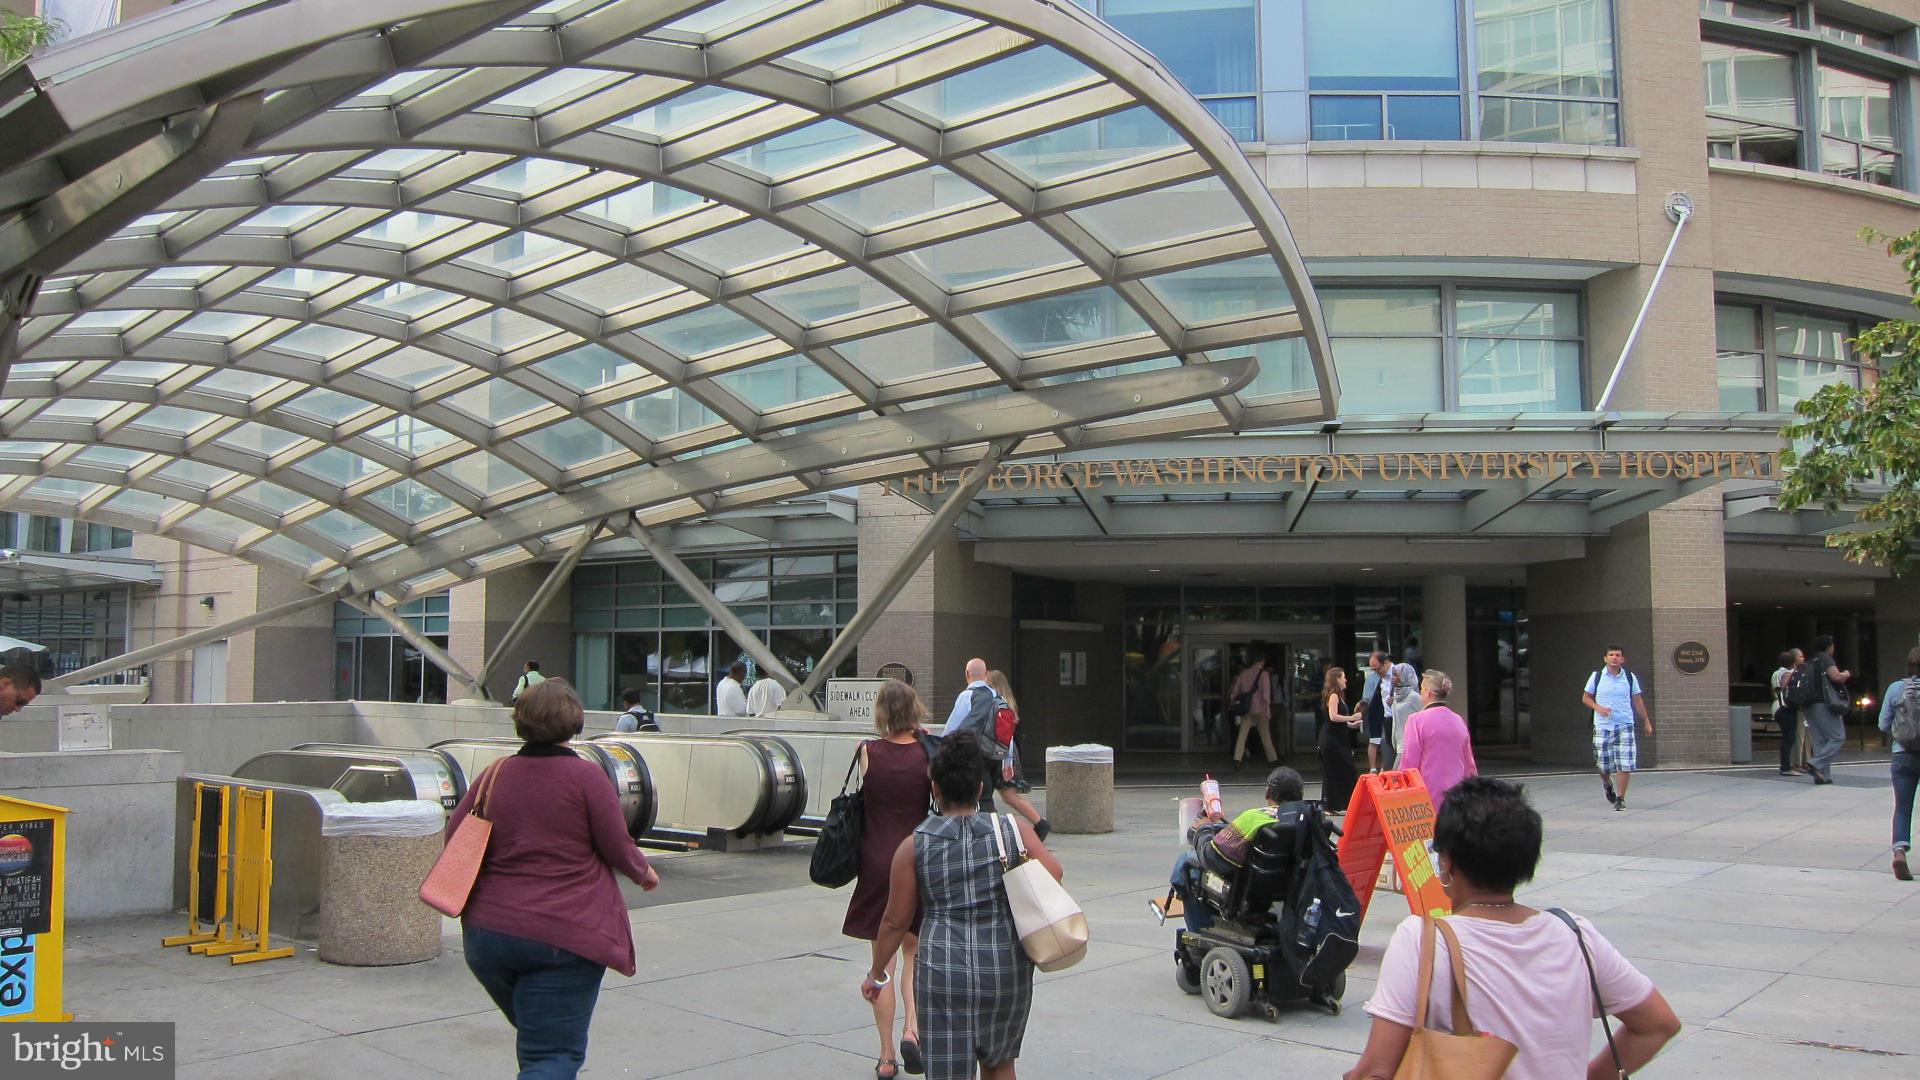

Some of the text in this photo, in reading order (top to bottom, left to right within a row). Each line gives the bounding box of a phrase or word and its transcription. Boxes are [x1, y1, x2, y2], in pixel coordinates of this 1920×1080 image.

[1110, 454, 1364, 488] WASHINGTON
[1375, 451, 1605, 481] UNIVERSITY
[1617, 451, 1787, 480] HOSPITAL
[830, 691, 878, 701] SIDEWALK CLO
[849, 707, 870, 717] AHEAD
[1384, 802, 1433, 826] FARMERS
[1390, 822, 1433, 845] MARKET
